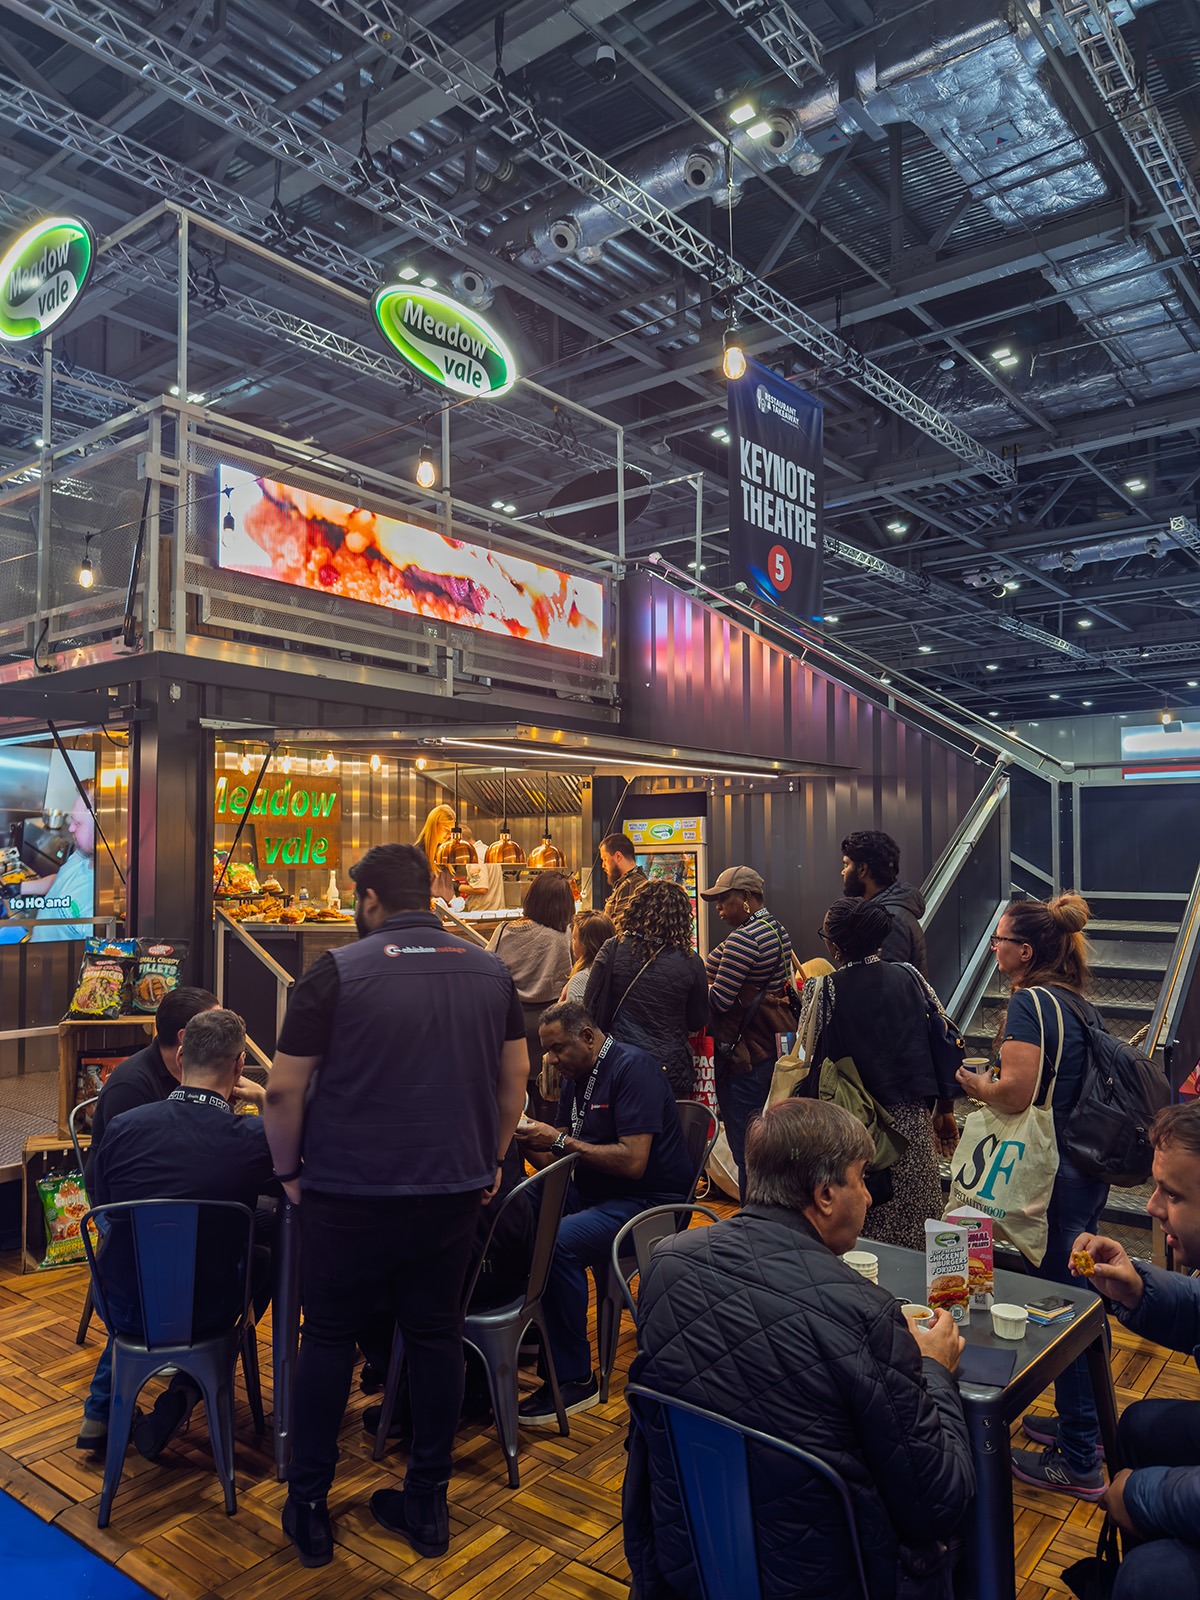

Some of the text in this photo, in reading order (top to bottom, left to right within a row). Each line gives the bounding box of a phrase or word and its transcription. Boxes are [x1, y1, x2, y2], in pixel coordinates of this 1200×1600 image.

[10, 241, 70, 300] Meadow
[38, 276, 68, 316] vale
[403, 298, 487, 359] Meadow
[444, 355, 483, 388] vale
[765, 392, 797, 416] RESTAURANT
[772, 404, 799, 425] TAKEAWAY
[739, 436, 815, 509] KEYNOTE
[741, 479, 816, 549] THEATRE
[775, 553, 785, 582] 5
[264, 827, 329, 865] vale
[10, 895, 71, 910] to HQ and
[139, 963, 178, 975] FILLETS
[954, 1133, 1025, 1200] SF
[928, 1253, 960, 1263] CHICKEN
[936, 1257, 968, 1268] BURGERS
